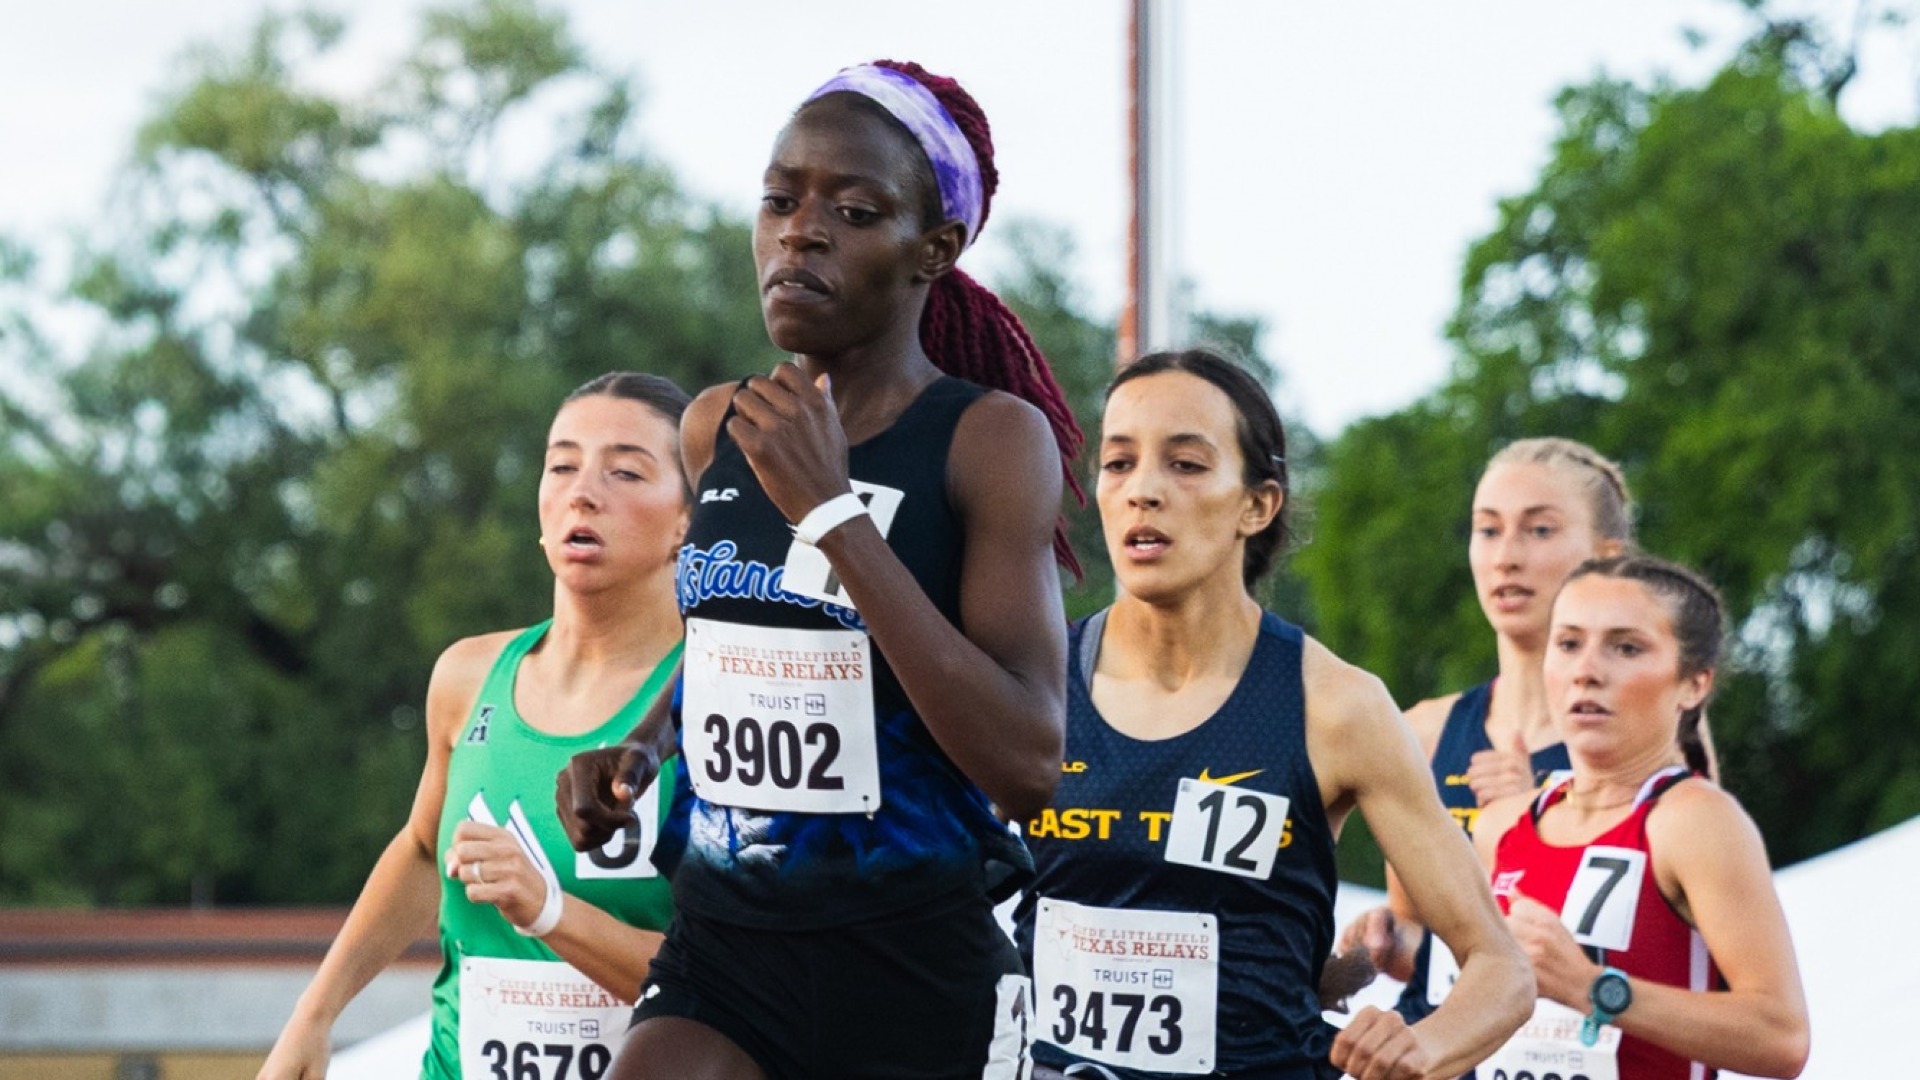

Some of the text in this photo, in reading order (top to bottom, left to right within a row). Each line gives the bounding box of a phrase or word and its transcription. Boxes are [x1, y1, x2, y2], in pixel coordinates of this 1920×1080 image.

[718, 644, 862, 662] CLYDE LITTLEFIELD
[719, 656, 864, 681] TEXAS RELAYS
[749, 693, 800, 711] TRUIST
[704, 713, 845, 791] 3902
[1198, 789, 1267, 872] 12
[1577, 856, 1631, 937] 7
[1073, 934, 1209, 960] TEXAS RELAYS
[1111, 929, 1209, 944] LITTLEFIELD
[1093, 968, 1149, 985] TRUIST
[500, 990, 622, 1008] TEXAS RELA
[527, 1020, 577, 1035] TRUIST
[1052, 984, 1183, 1055] 3473
